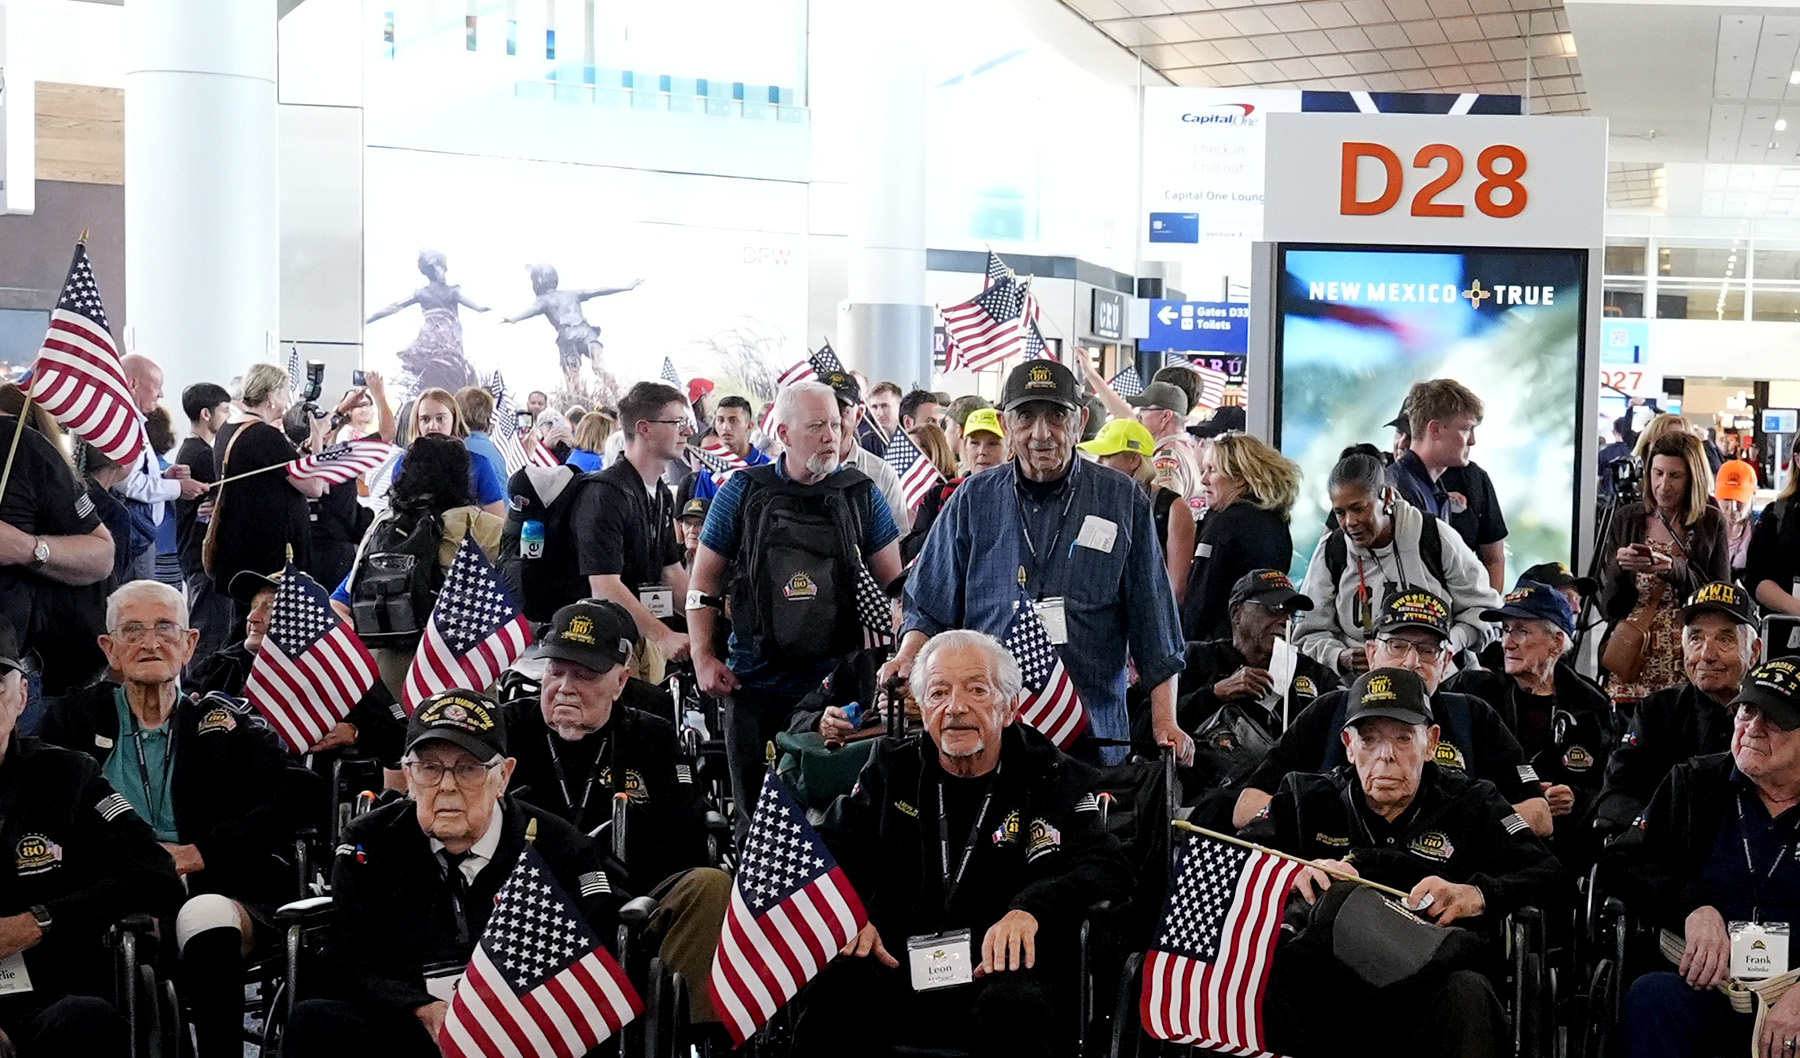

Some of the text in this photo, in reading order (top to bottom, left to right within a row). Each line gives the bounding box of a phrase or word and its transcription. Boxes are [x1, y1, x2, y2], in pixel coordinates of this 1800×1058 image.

[1192, 142, 1245, 156] Check in
[1192, 162, 1245, 175] Chill out
[1340, 141, 1529, 219] D28
[1164, 190, 1203, 202] Capital
[1206, 191, 1229, 201] One
[743, 246, 791, 265] DFW
[1309, 282, 1555, 306] NEW MEXICO TRUE
[1197, 306, 1227, 318] Gates
[1196, 319, 1232, 331] Toilets
[1766, 661, 1796, 673] AIRBORNE
[22, 845, 45, 858] 80
[1745, 955, 1772, 965] Frank
[928, 965, 952, 975] Leon
